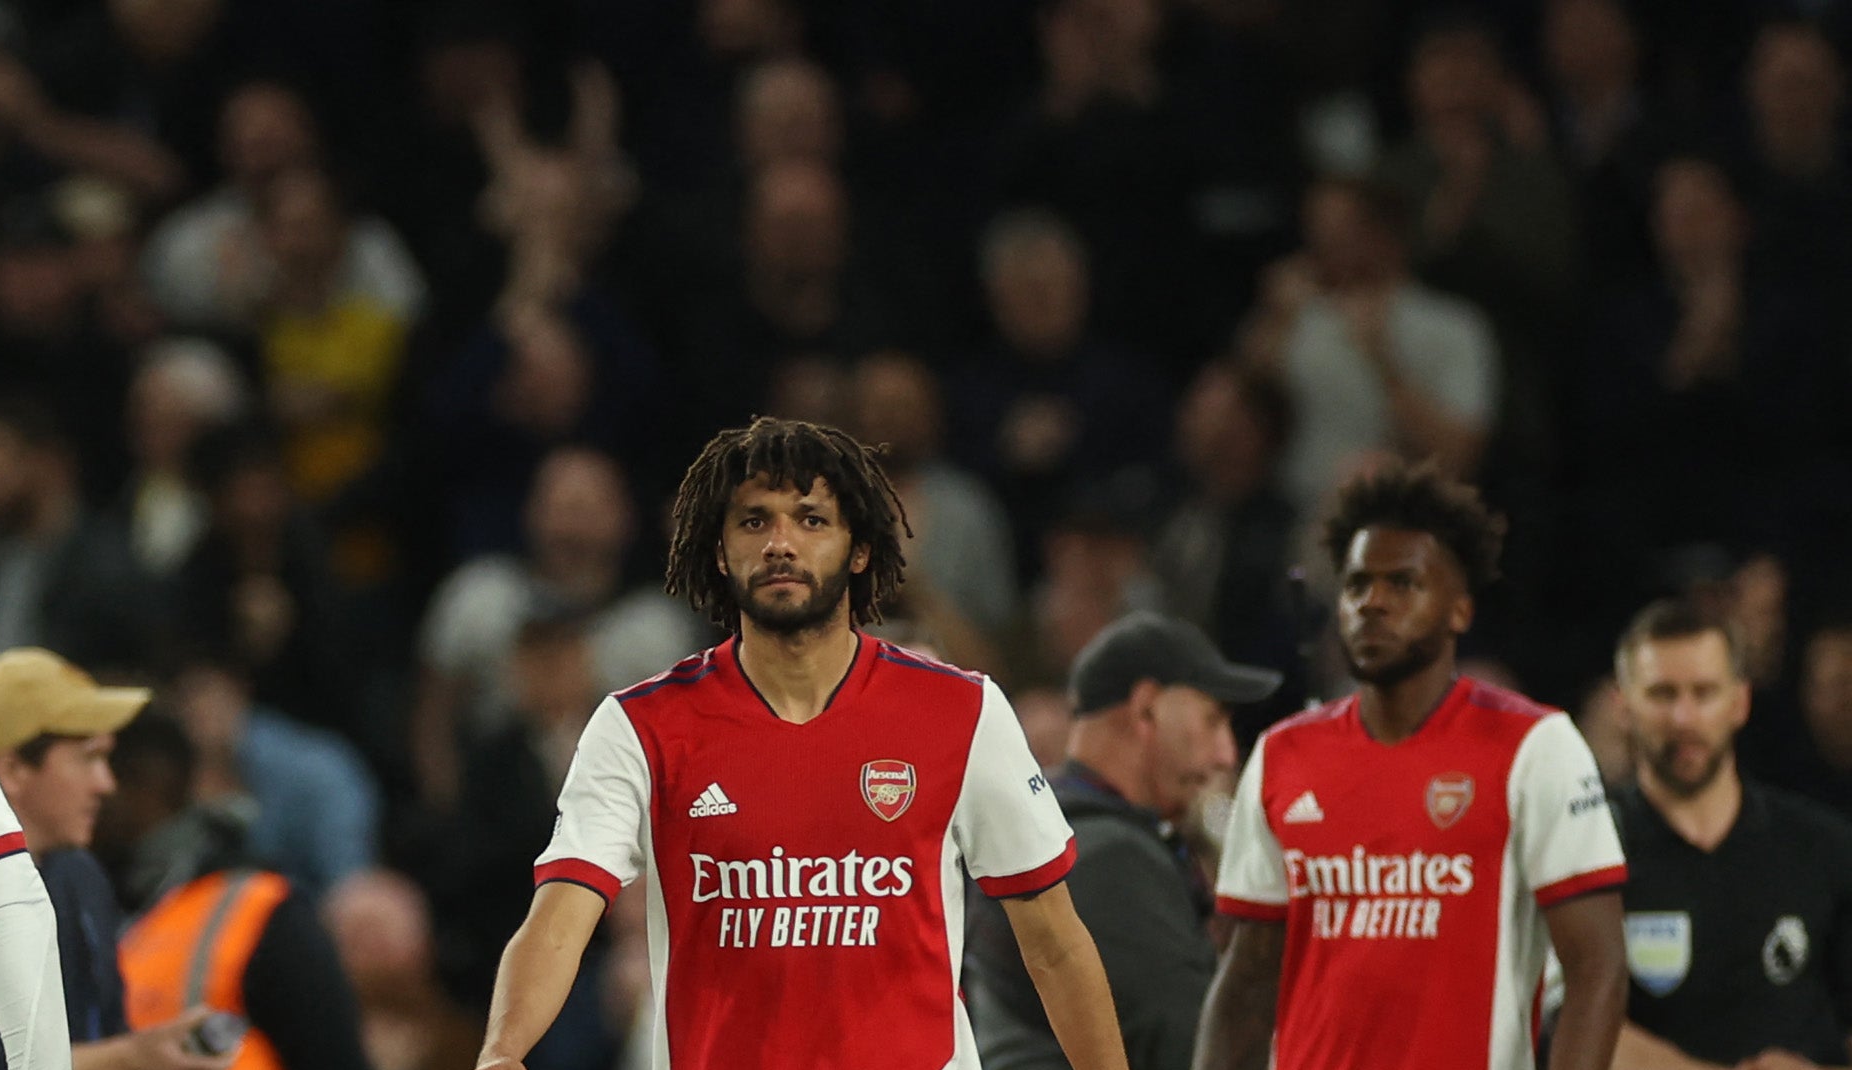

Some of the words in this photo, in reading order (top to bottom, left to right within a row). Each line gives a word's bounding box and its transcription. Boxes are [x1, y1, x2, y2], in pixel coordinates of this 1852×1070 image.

[689, 802, 738, 818] adidas
[688, 846, 913, 903] Emirates
[1283, 845, 1474, 896] Emirates
[718, 906, 765, 949] FLY
[770, 905, 881, 948] BETTER
[1350, 898, 1442, 939] BETTER
